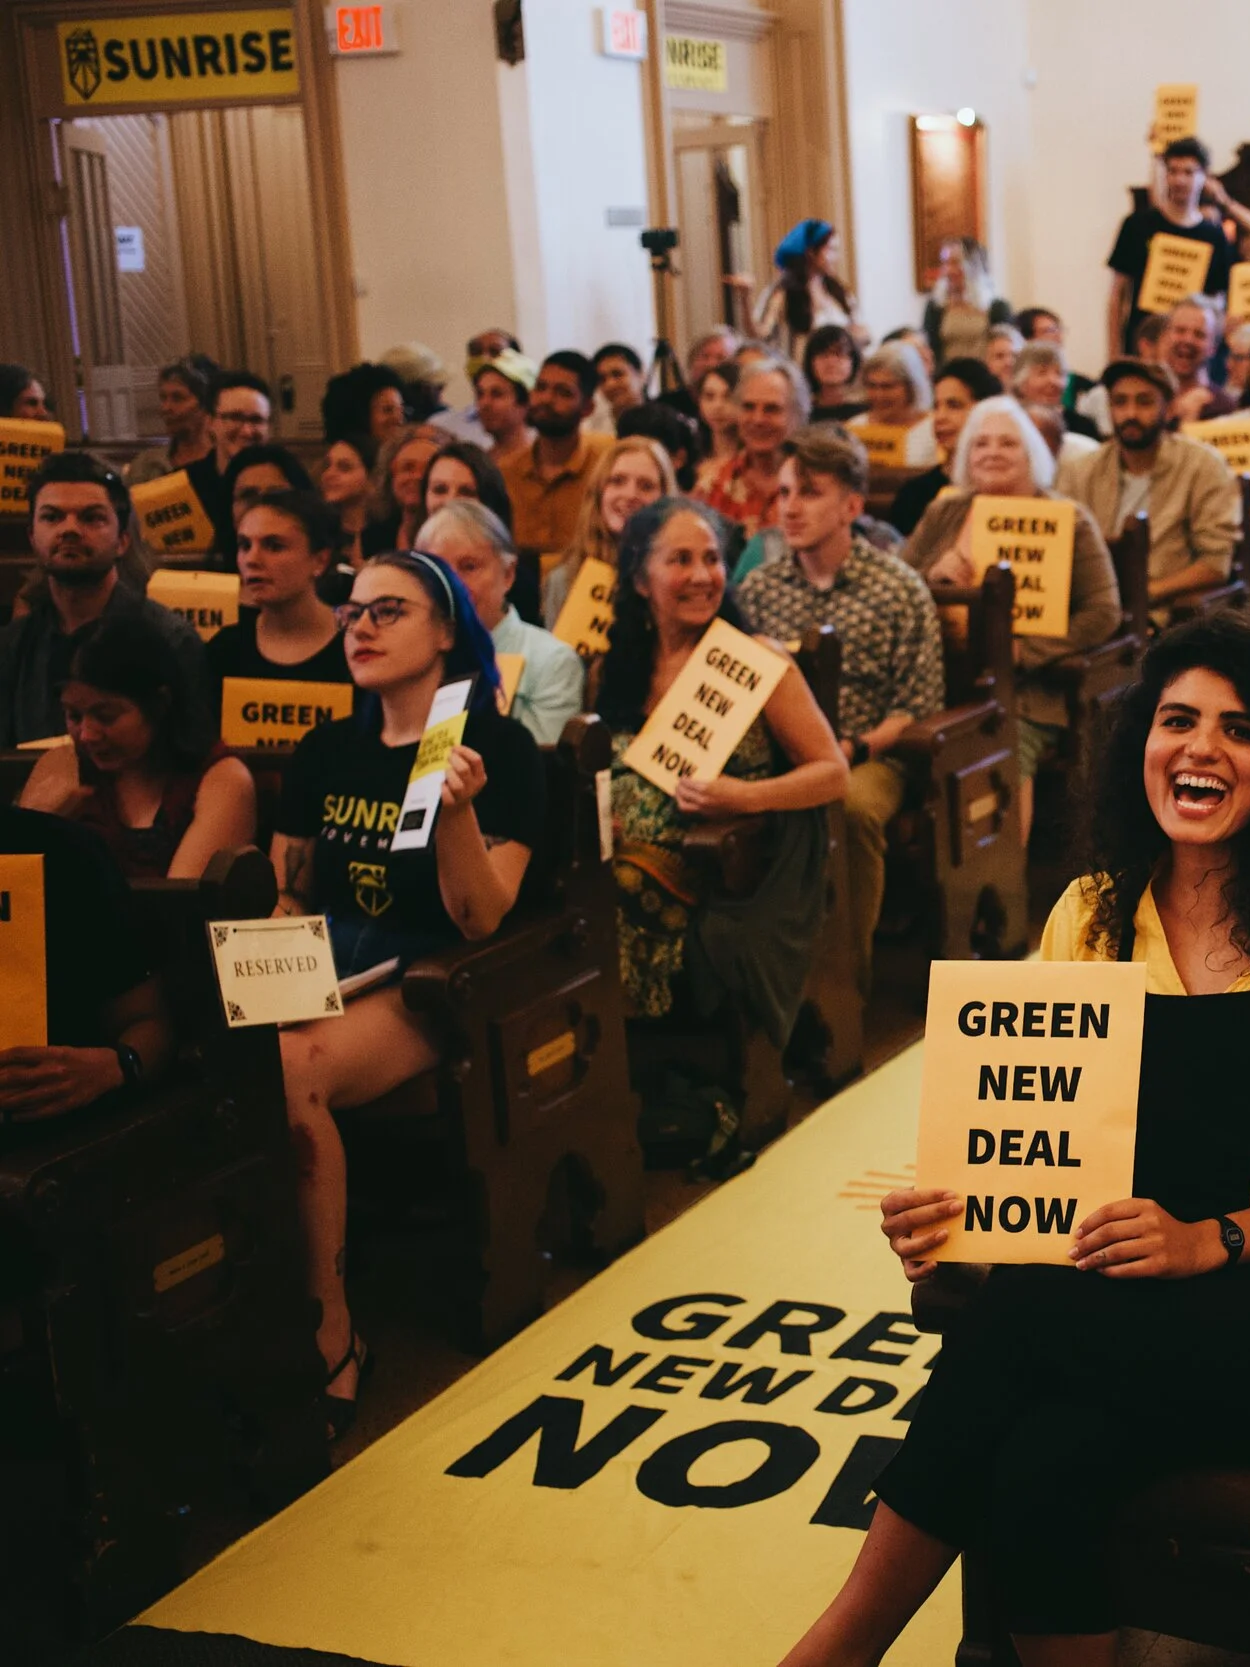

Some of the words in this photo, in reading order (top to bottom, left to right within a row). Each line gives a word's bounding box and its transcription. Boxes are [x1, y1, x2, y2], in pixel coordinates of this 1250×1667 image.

[337, 6, 383, 51] EXIT
[104, 28, 294, 82] SUNRISE
[986, 516, 1059, 535] GREEN
[997, 545, 1046, 562] NEW
[1019, 575, 1046, 593] AL
[1012, 603, 1045, 620] OW
[705, 647, 762, 692] GREEN
[241, 701, 333, 726] GREEN
[693, 683, 734, 718] NEW
[672, 712, 715, 752] DEAL
[651, 743, 698, 778] NOW
[323, 793, 400, 833] SUNR
[234, 955, 318, 978] RESERVED
[957, 1001, 1110, 1039] GREEN
[978, 1065, 1082, 1102] NEW
[967, 1128, 1081, 1168] DEAL
[964, 1195, 1078, 1235] NOW
[631, 1292, 940, 1369] GRE
[554, 1344, 814, 1405] NEW
